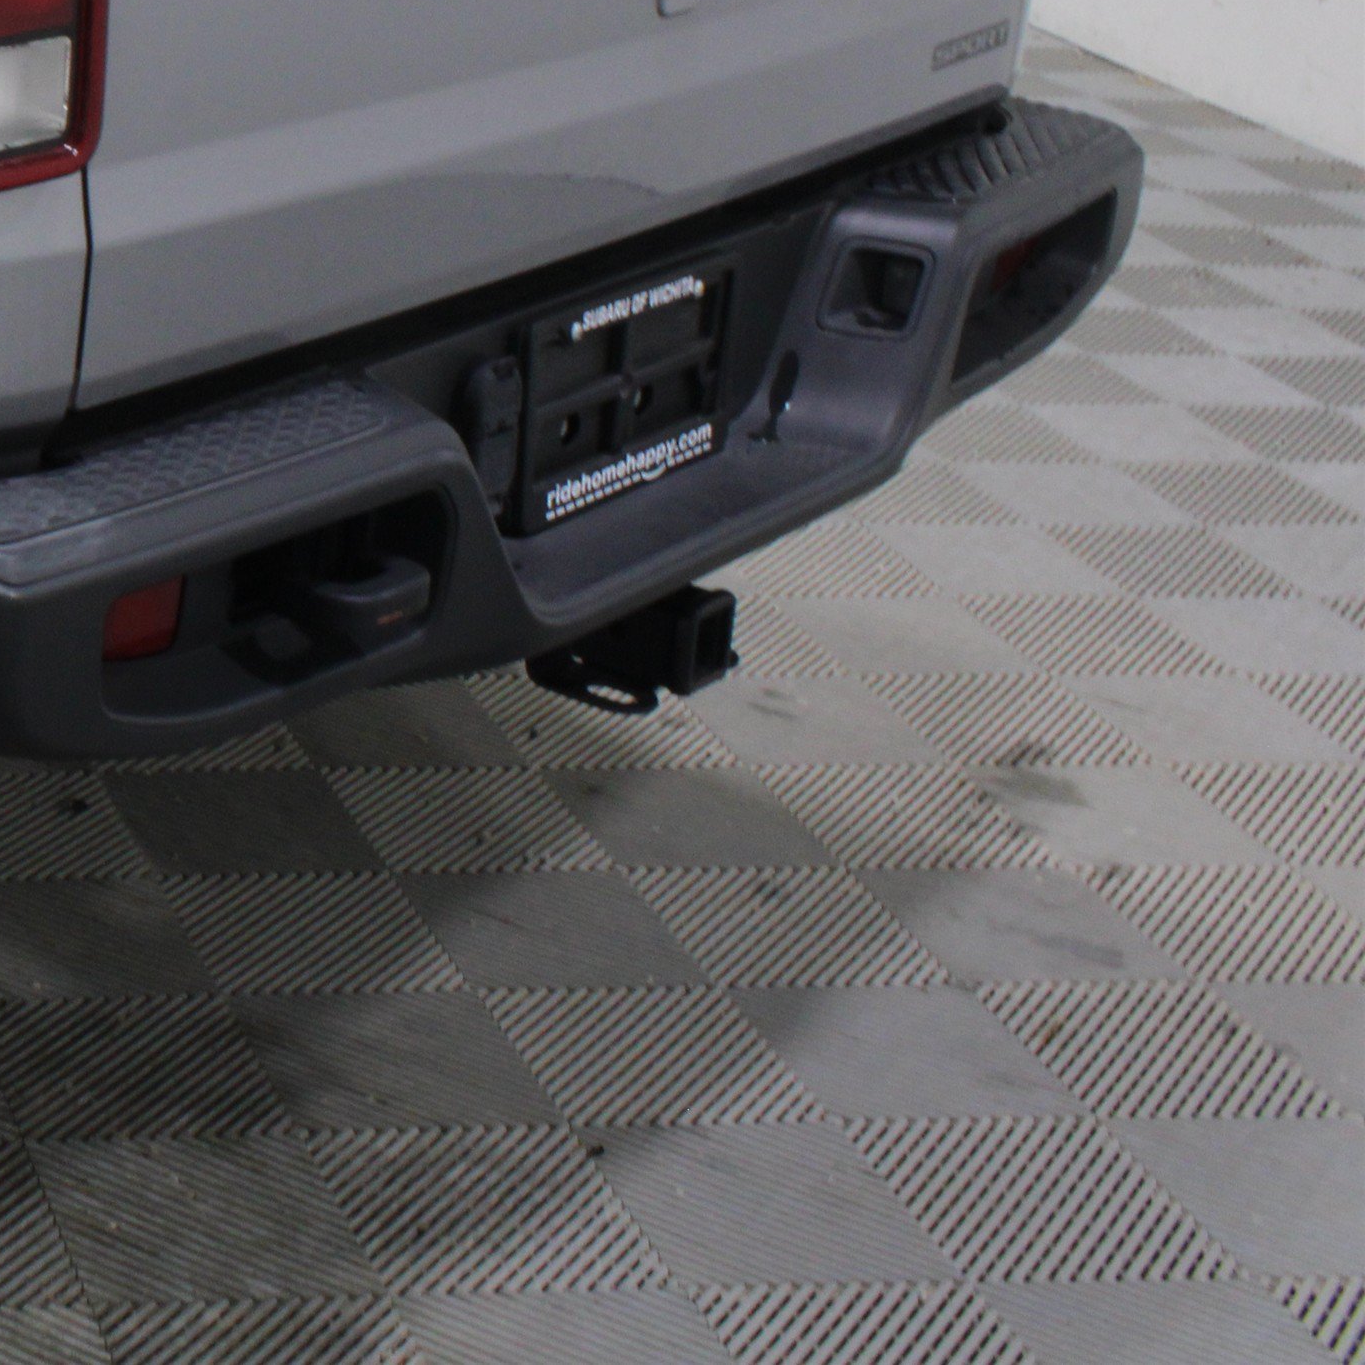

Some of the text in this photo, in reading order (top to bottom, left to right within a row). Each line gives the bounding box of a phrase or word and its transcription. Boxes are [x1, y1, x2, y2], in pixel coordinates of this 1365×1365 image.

[582, 296, 630, 331] SUBARU
[631, 290, 648, 314] OF
[546, 422, 712, 509] ridehomehappy.com
